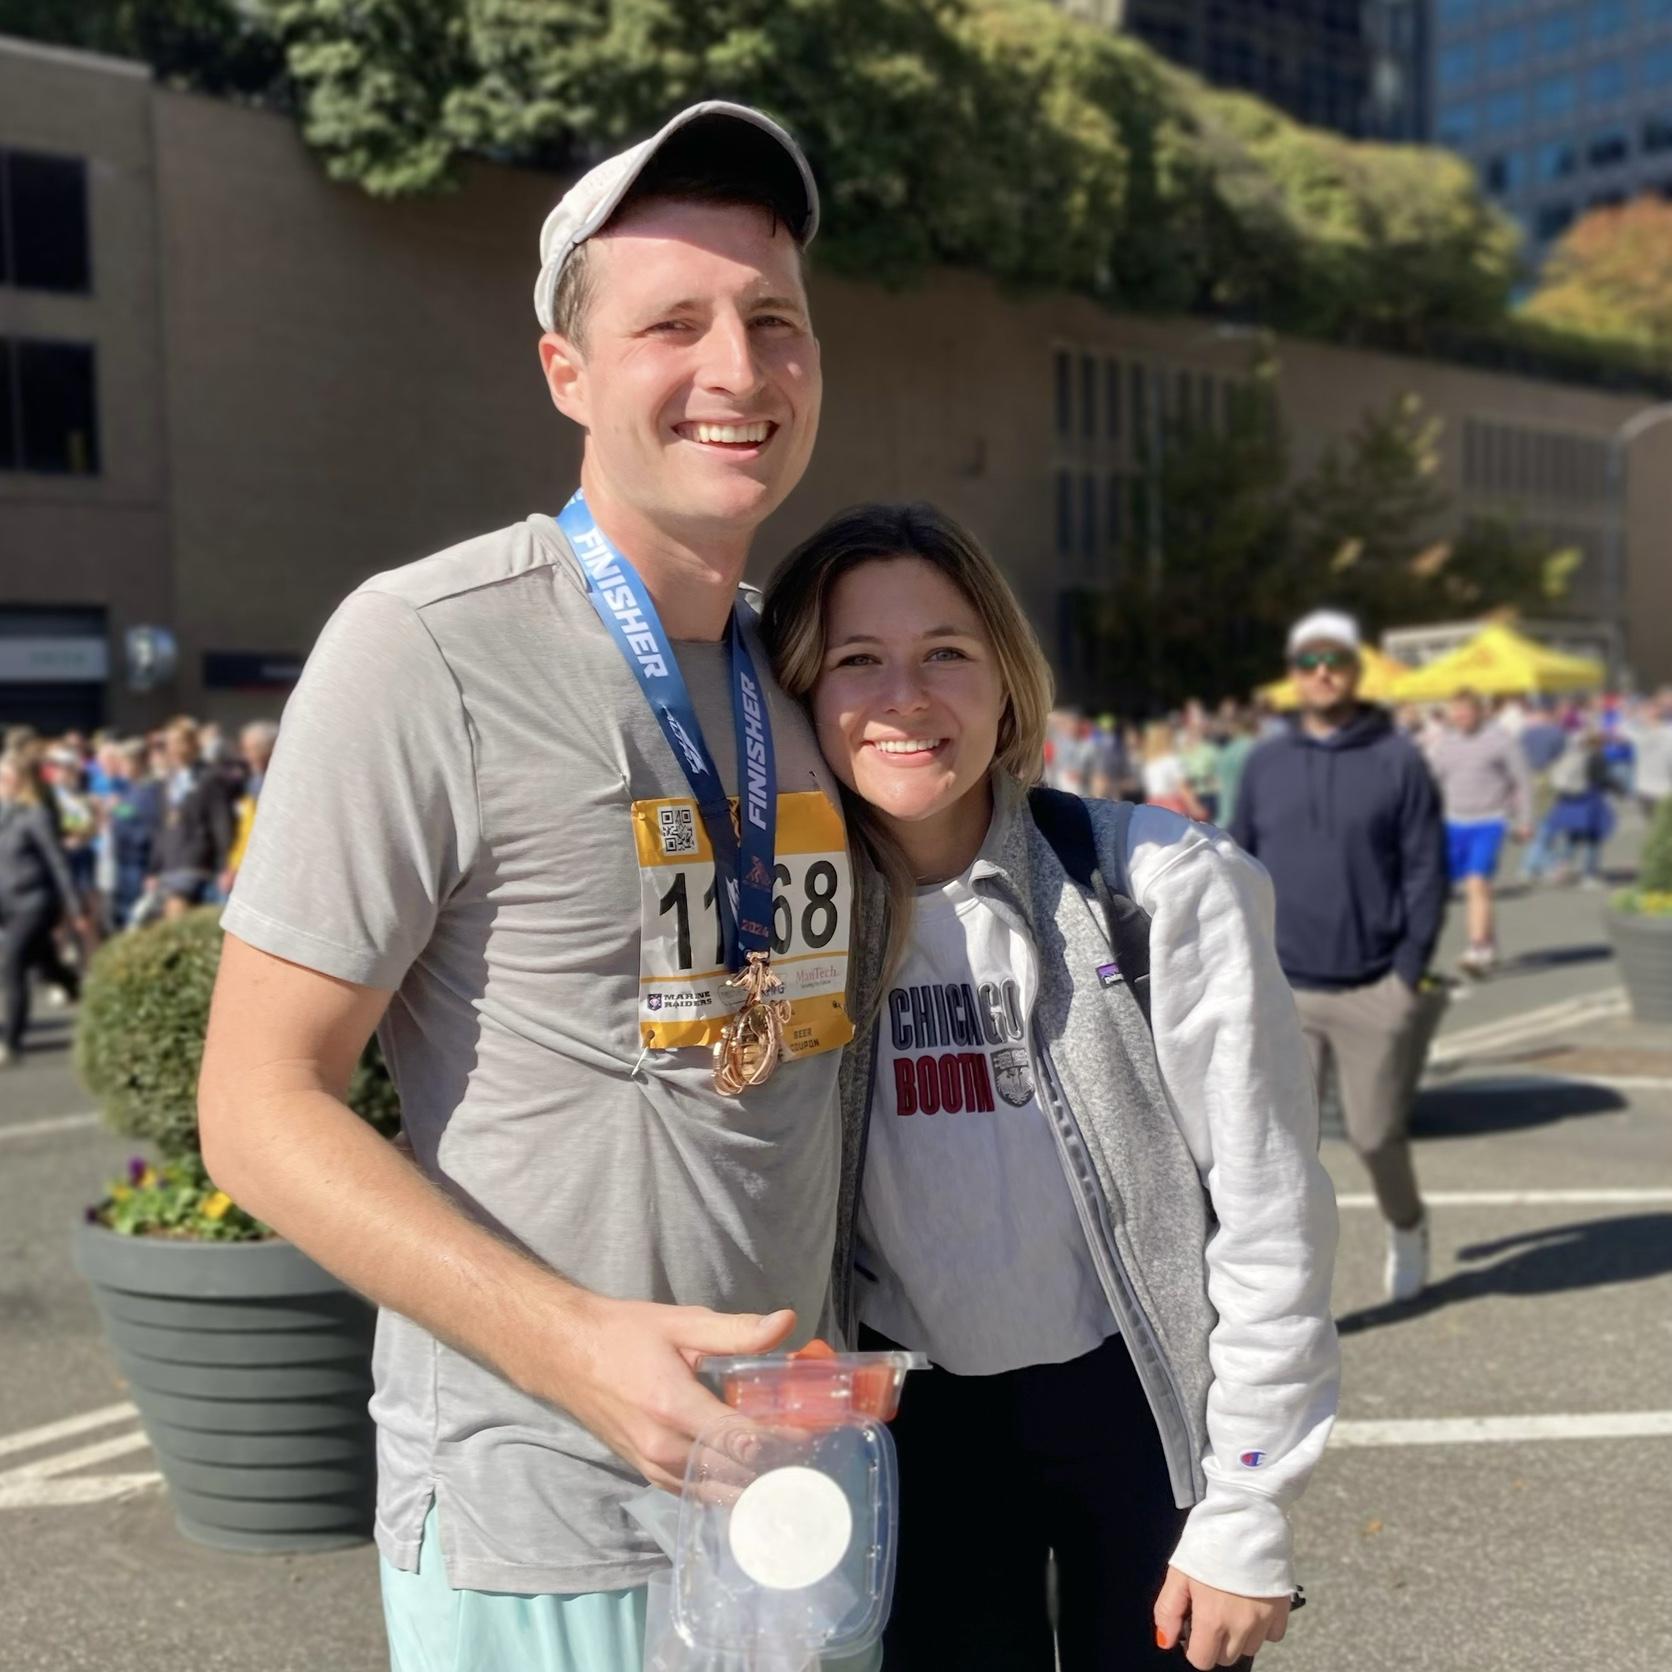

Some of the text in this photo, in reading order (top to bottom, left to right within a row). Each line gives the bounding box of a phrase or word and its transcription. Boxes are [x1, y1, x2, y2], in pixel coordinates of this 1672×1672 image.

[573, 526, 669, 679] FINISHER
[740, 671, 768, 831] FINISHER
[741, 919, 769, 938] 2024
[664, 991, 711, 1001] MARINE
[664, 998, 713, 1009] RAIDERS
[888, 977, 1024, 1051] CHICAGO
[793, 1027, 812, 1040] BEER
